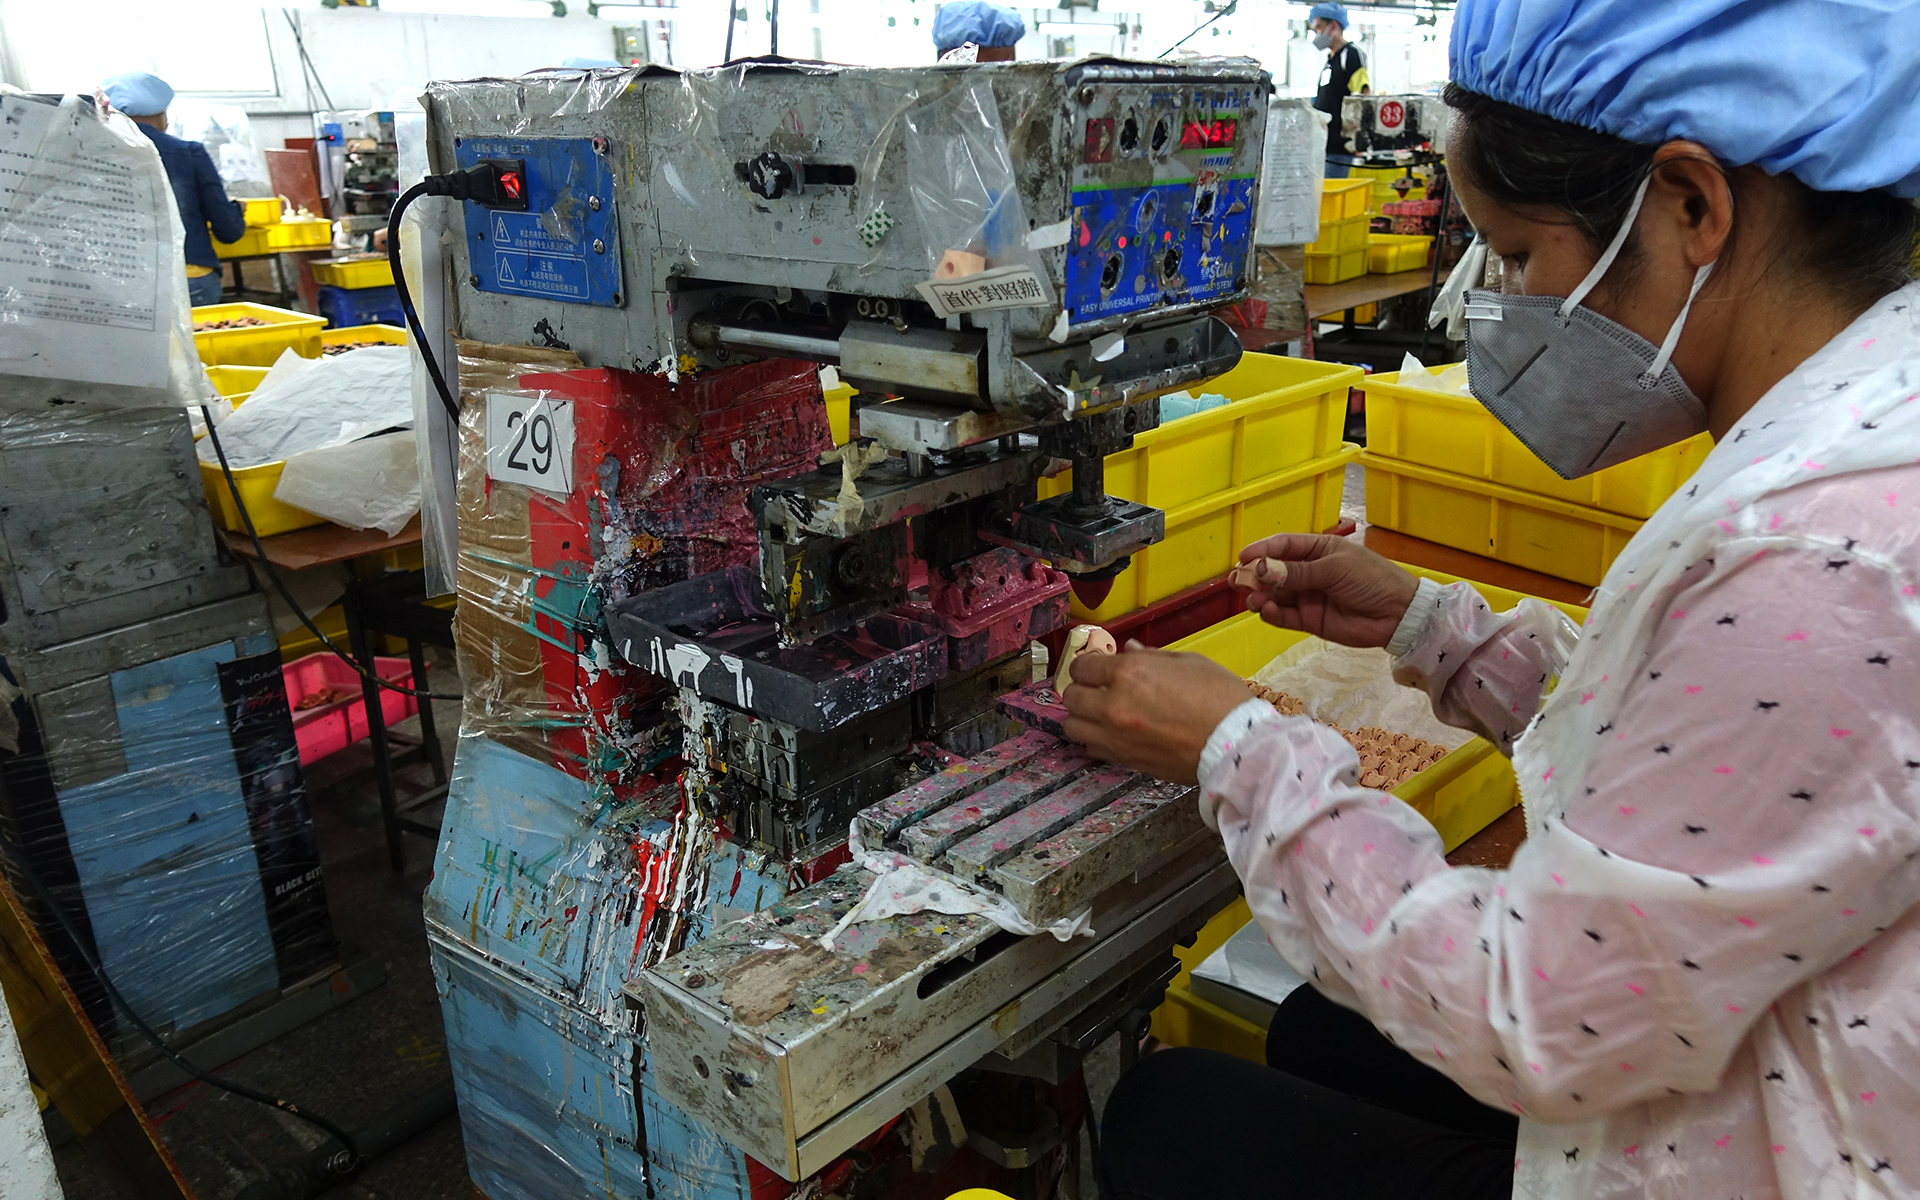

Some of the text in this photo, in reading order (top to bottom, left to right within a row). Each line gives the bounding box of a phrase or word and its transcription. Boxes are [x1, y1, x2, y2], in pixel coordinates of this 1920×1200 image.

[1382, 105, 1401, 124] 33
[540, 260, 554, 272] 注意
[942, 277, 1041, 308] 首件對照辦
[1080, 303, 1098, 315] EASY
[1099, 294, 1135, 311] UNIVERSAL
[1135, 290, 1165, 305] PRINTING
[507, 411, 553, 475] 29
[275, 875, 304, 896] BLACK
